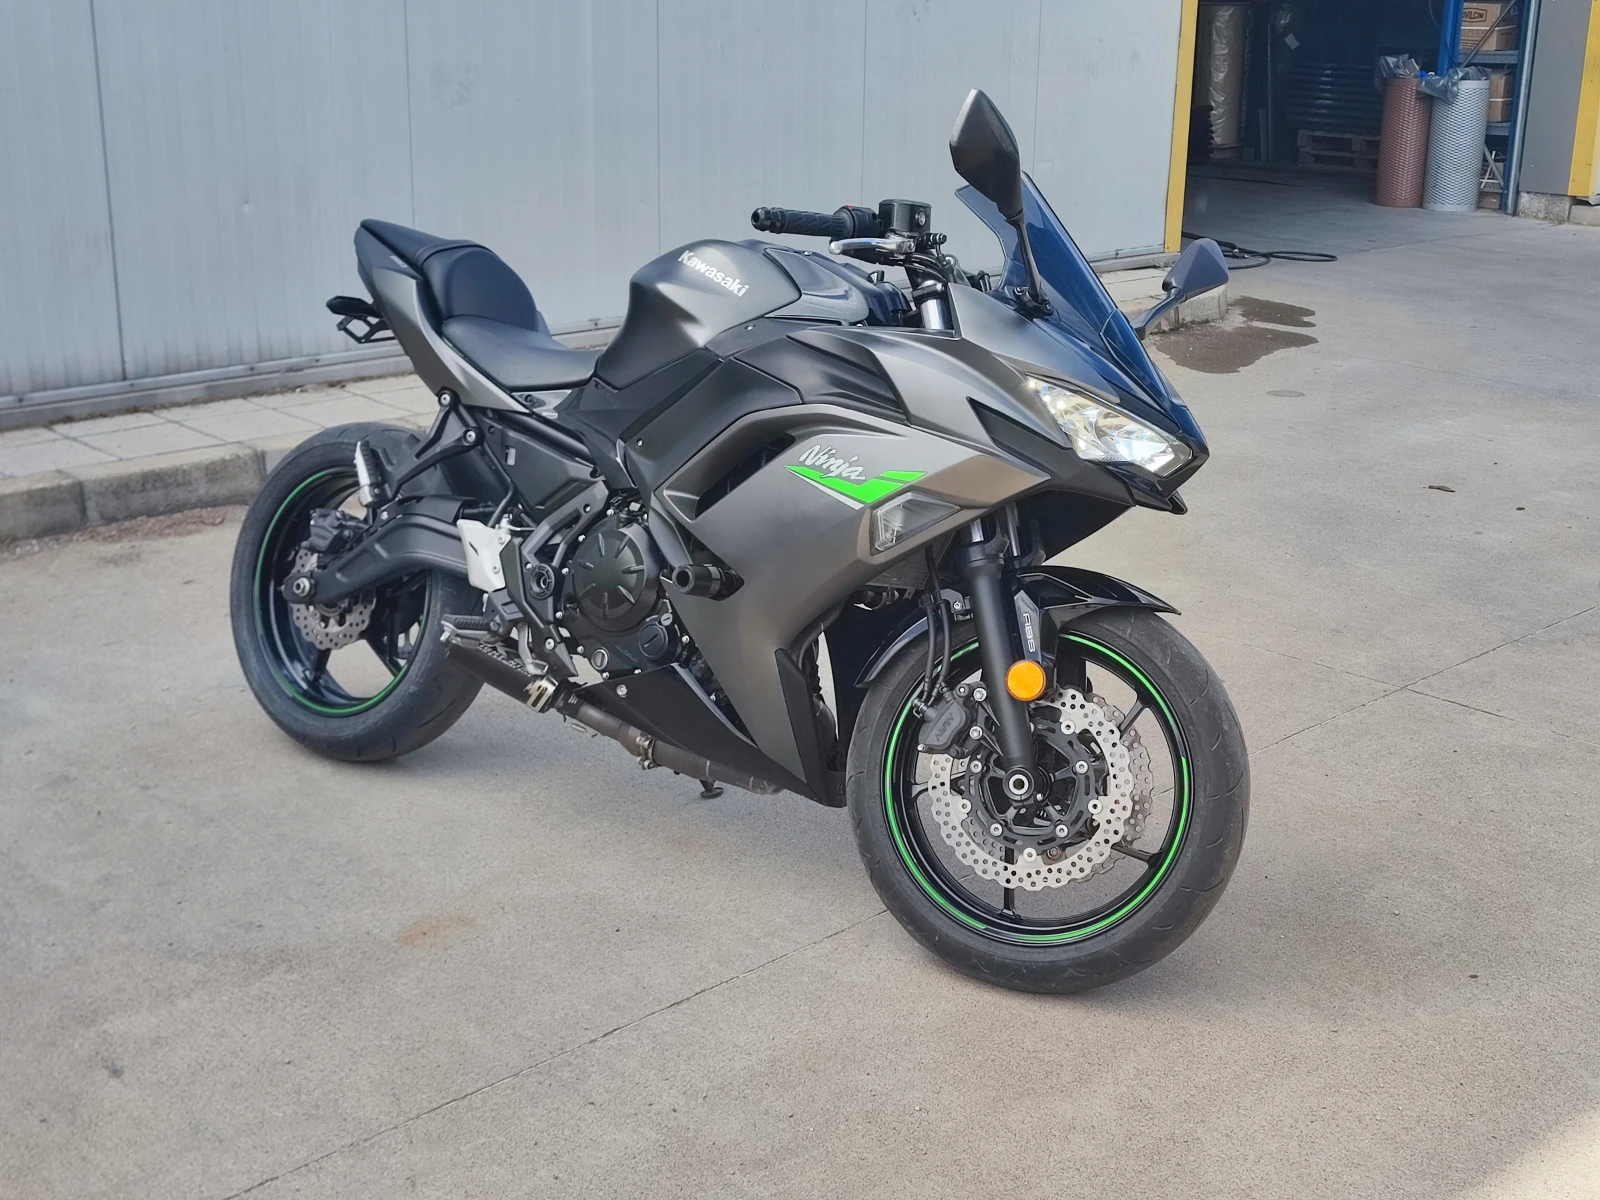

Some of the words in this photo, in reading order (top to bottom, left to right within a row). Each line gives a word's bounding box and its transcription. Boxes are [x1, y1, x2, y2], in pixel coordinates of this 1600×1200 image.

[677, 249, 750, 297] Kawasaki
[799, 444, 866, 480] Ninja
[1022, 612, 1036, 653] ABS
